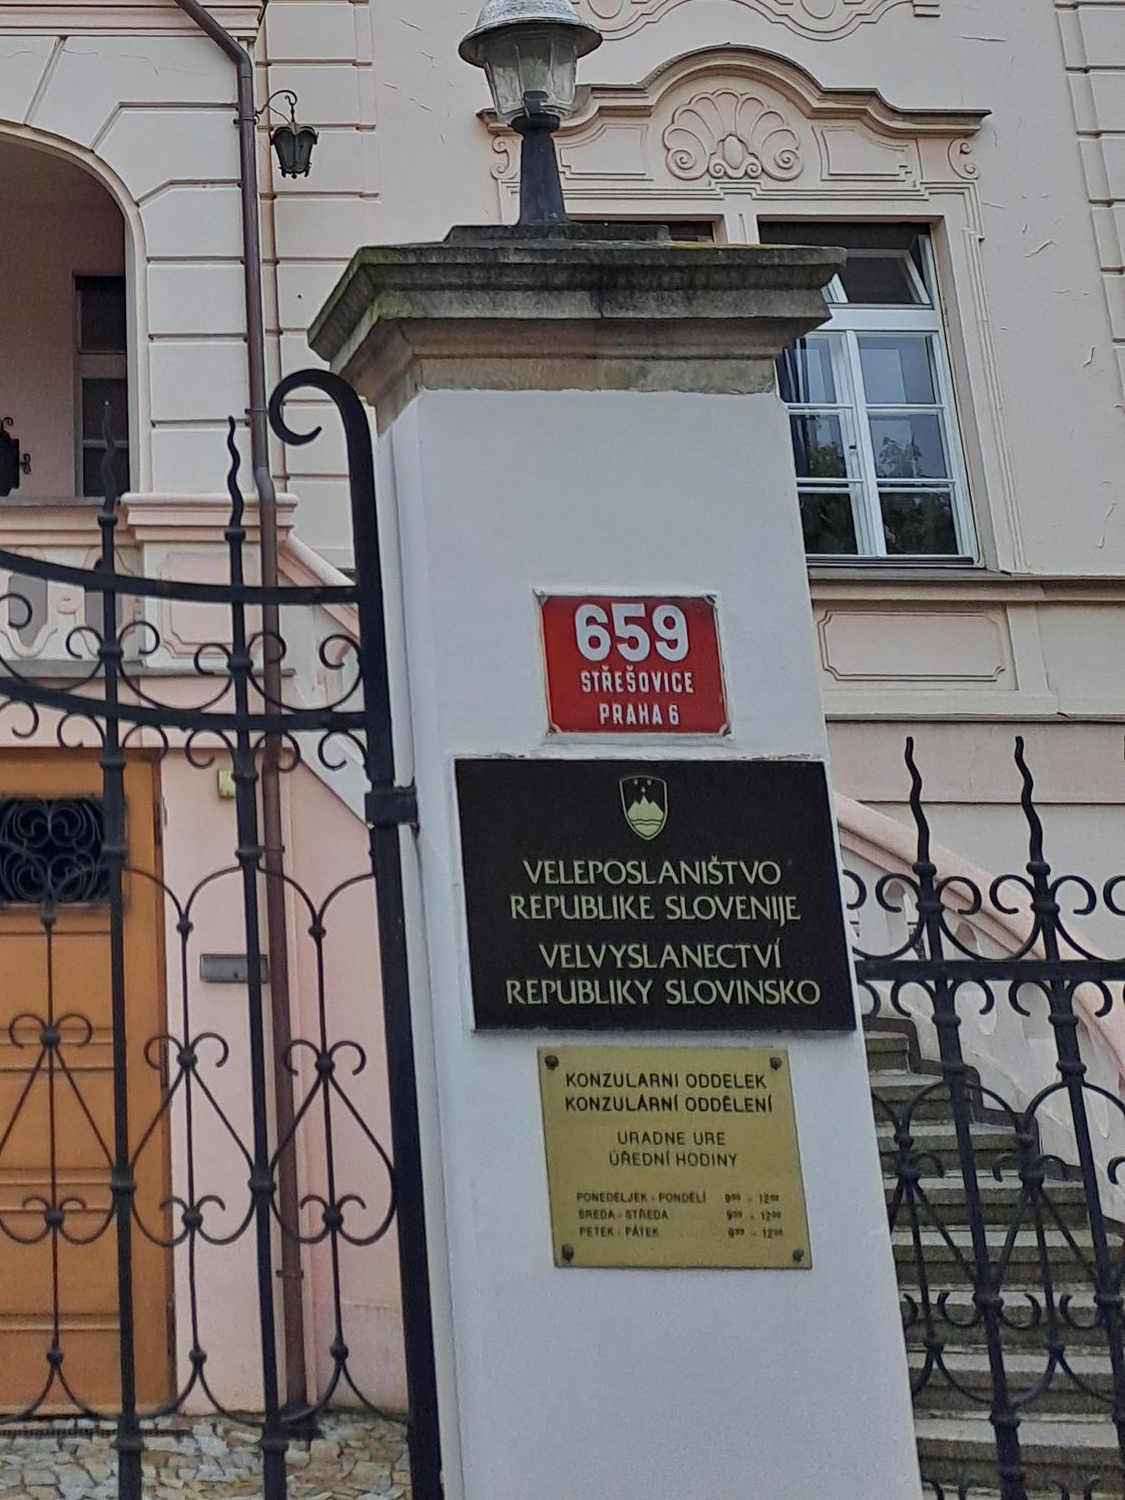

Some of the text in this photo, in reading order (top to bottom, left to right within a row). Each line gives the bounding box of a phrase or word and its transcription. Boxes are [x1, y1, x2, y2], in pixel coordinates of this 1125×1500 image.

[575, 602, 689, 662] 659
[581, 665, 694, 693] STŘEŠOVICE
[599, 703, 680, 725] PRAHA 6
[523, 855, 782, 886] VELEPOSLANIŠTVO
[510, 895, 801, 927] REPUBLIKE SLOVENIJE
[539, 938, 782, 969] VELVYSLANECTVÍ
[506, 979, 821, 1005] REPUBLIKY SLOVINSKO
[565, 1072, 768, 1089] KONZULARNI ODDELEK
[565, 1094, 679, 1113] KONZULÁRNÍ
[617, 1130, 727, 1146] URADNE URE
[676, 1152, 738, 1167] HODINY
